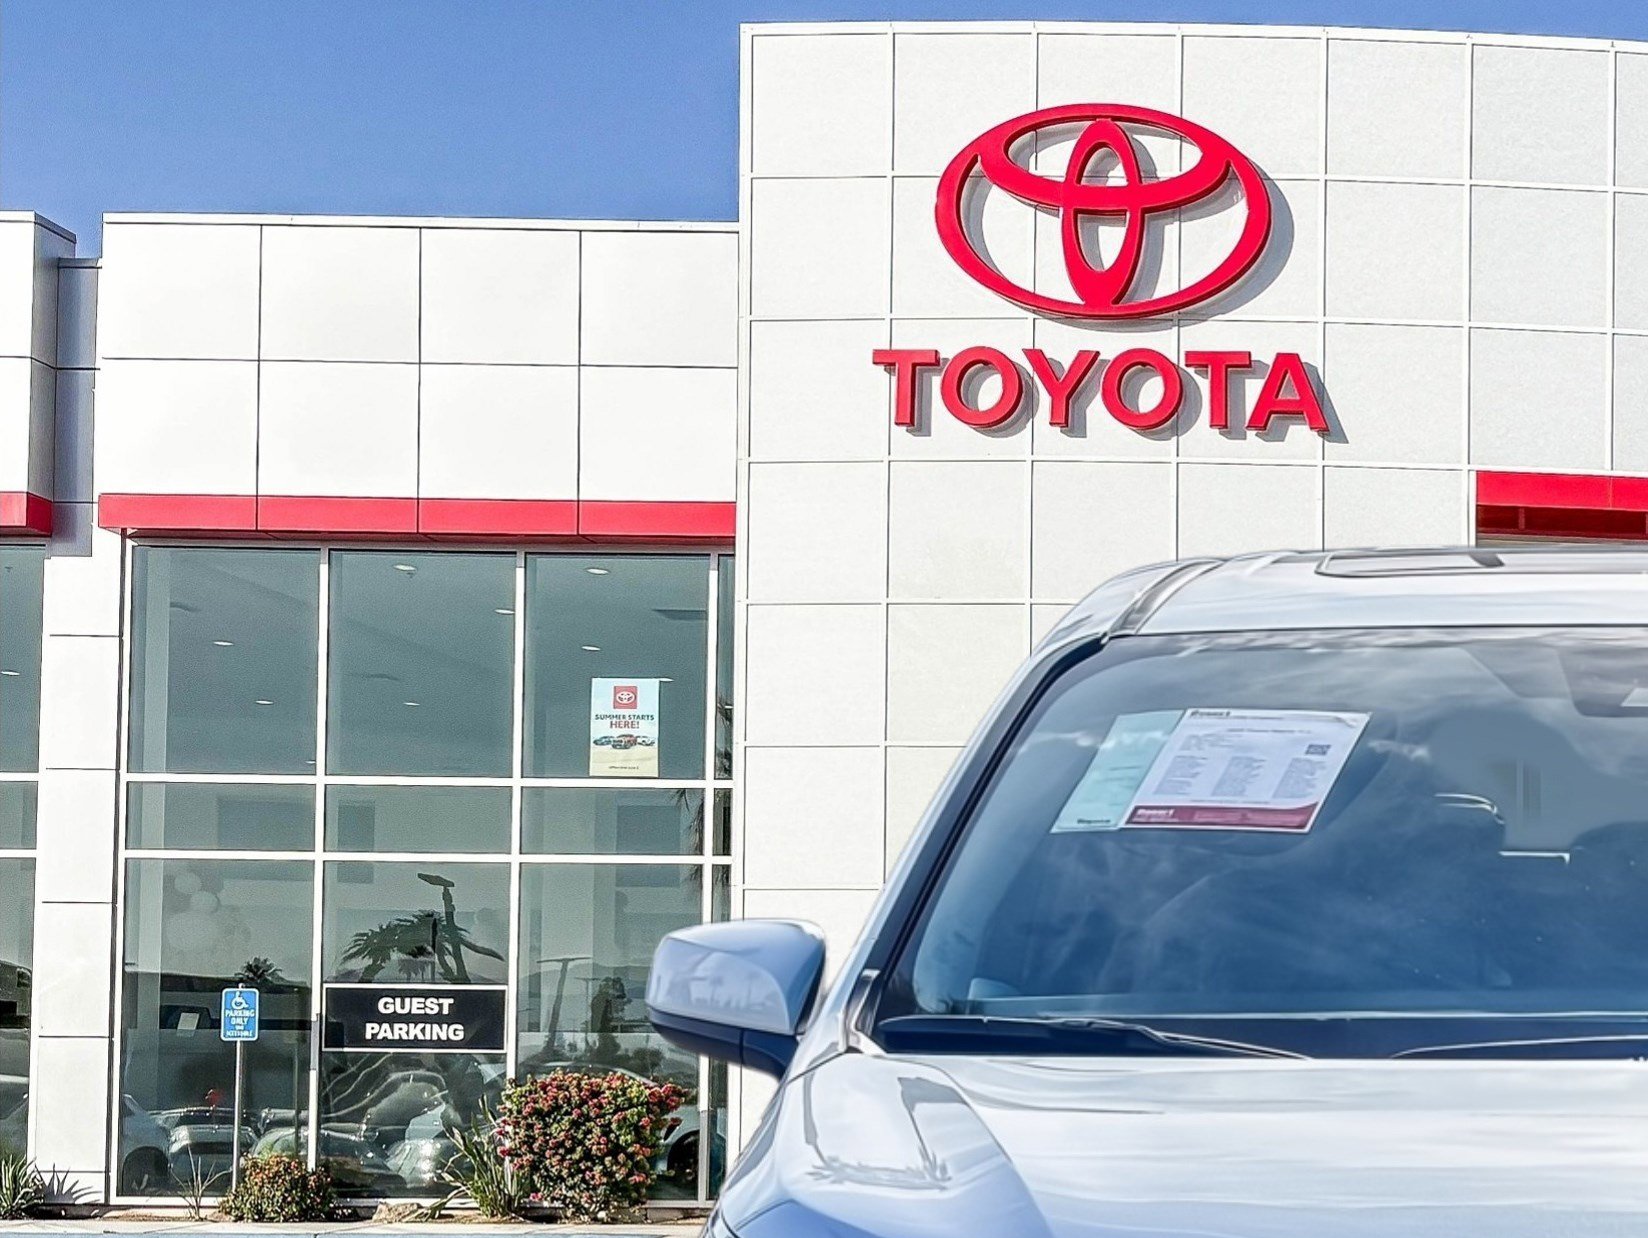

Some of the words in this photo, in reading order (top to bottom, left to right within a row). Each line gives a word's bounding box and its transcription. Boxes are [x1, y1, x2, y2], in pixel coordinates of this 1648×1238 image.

[872, 346, 1330, 433] TOYOTA
[609, 720, 640, 729] HERE!
[377, 997, 455, 1015] GUEST
[230, 1016, 249, 1025] ONLY
[365, 1022, 465, 1041] PARKING
